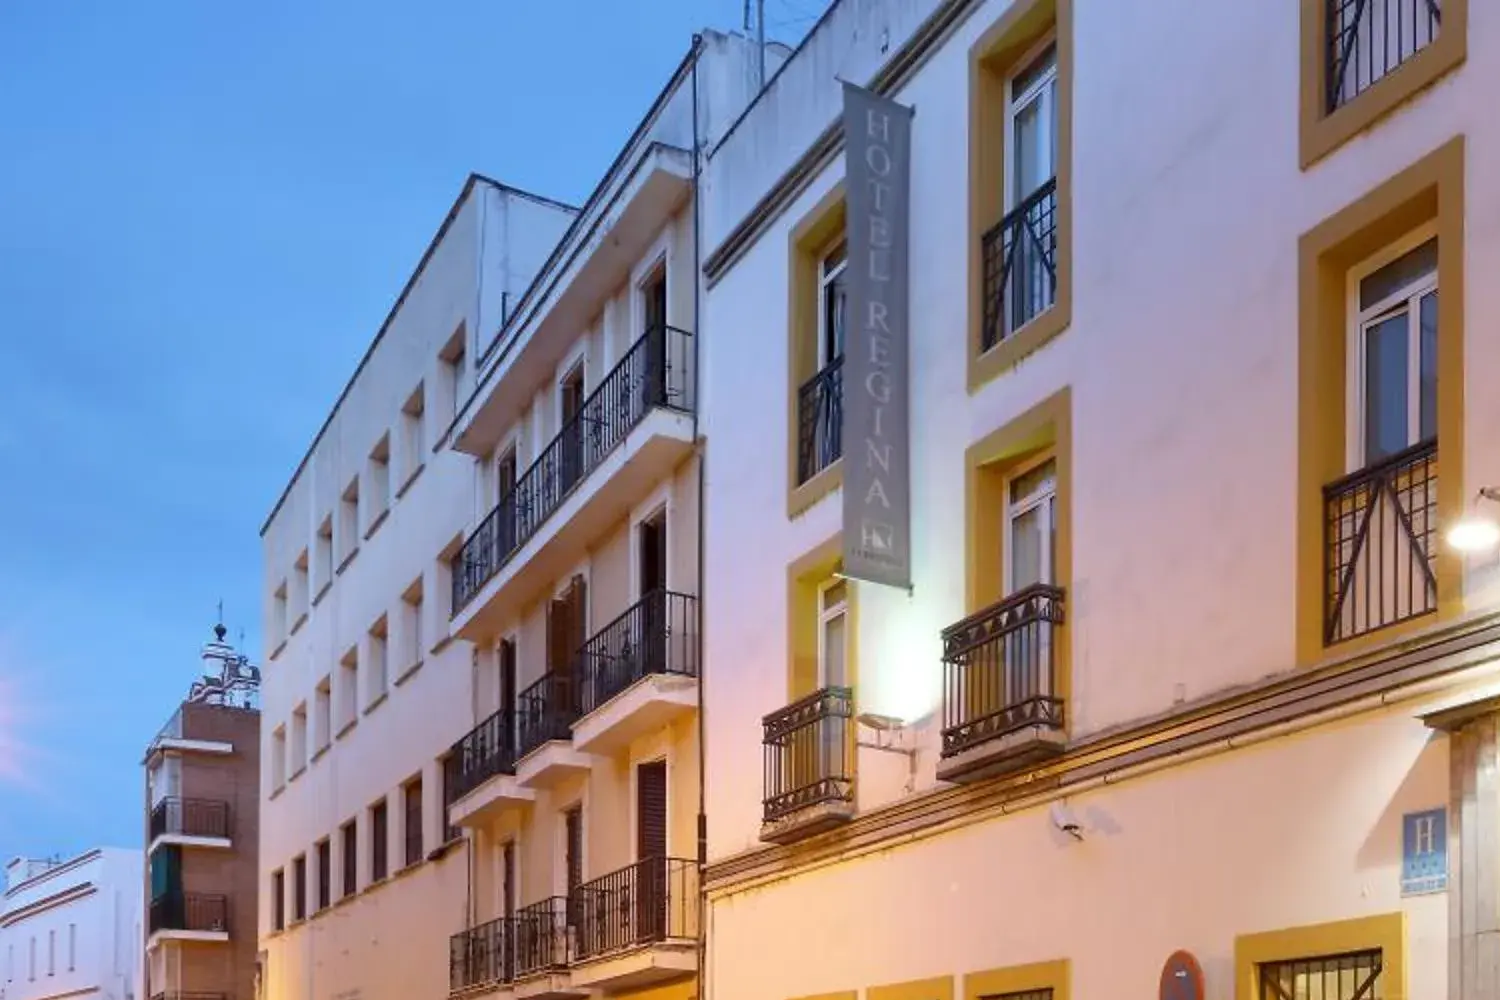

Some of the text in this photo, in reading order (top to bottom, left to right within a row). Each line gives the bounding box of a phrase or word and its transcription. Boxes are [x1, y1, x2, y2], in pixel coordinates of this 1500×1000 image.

[866, 107, 892, 281] HOTEL
[865, 301, 893, 509] REGINA
[1415, 816, 1436, 855] H
